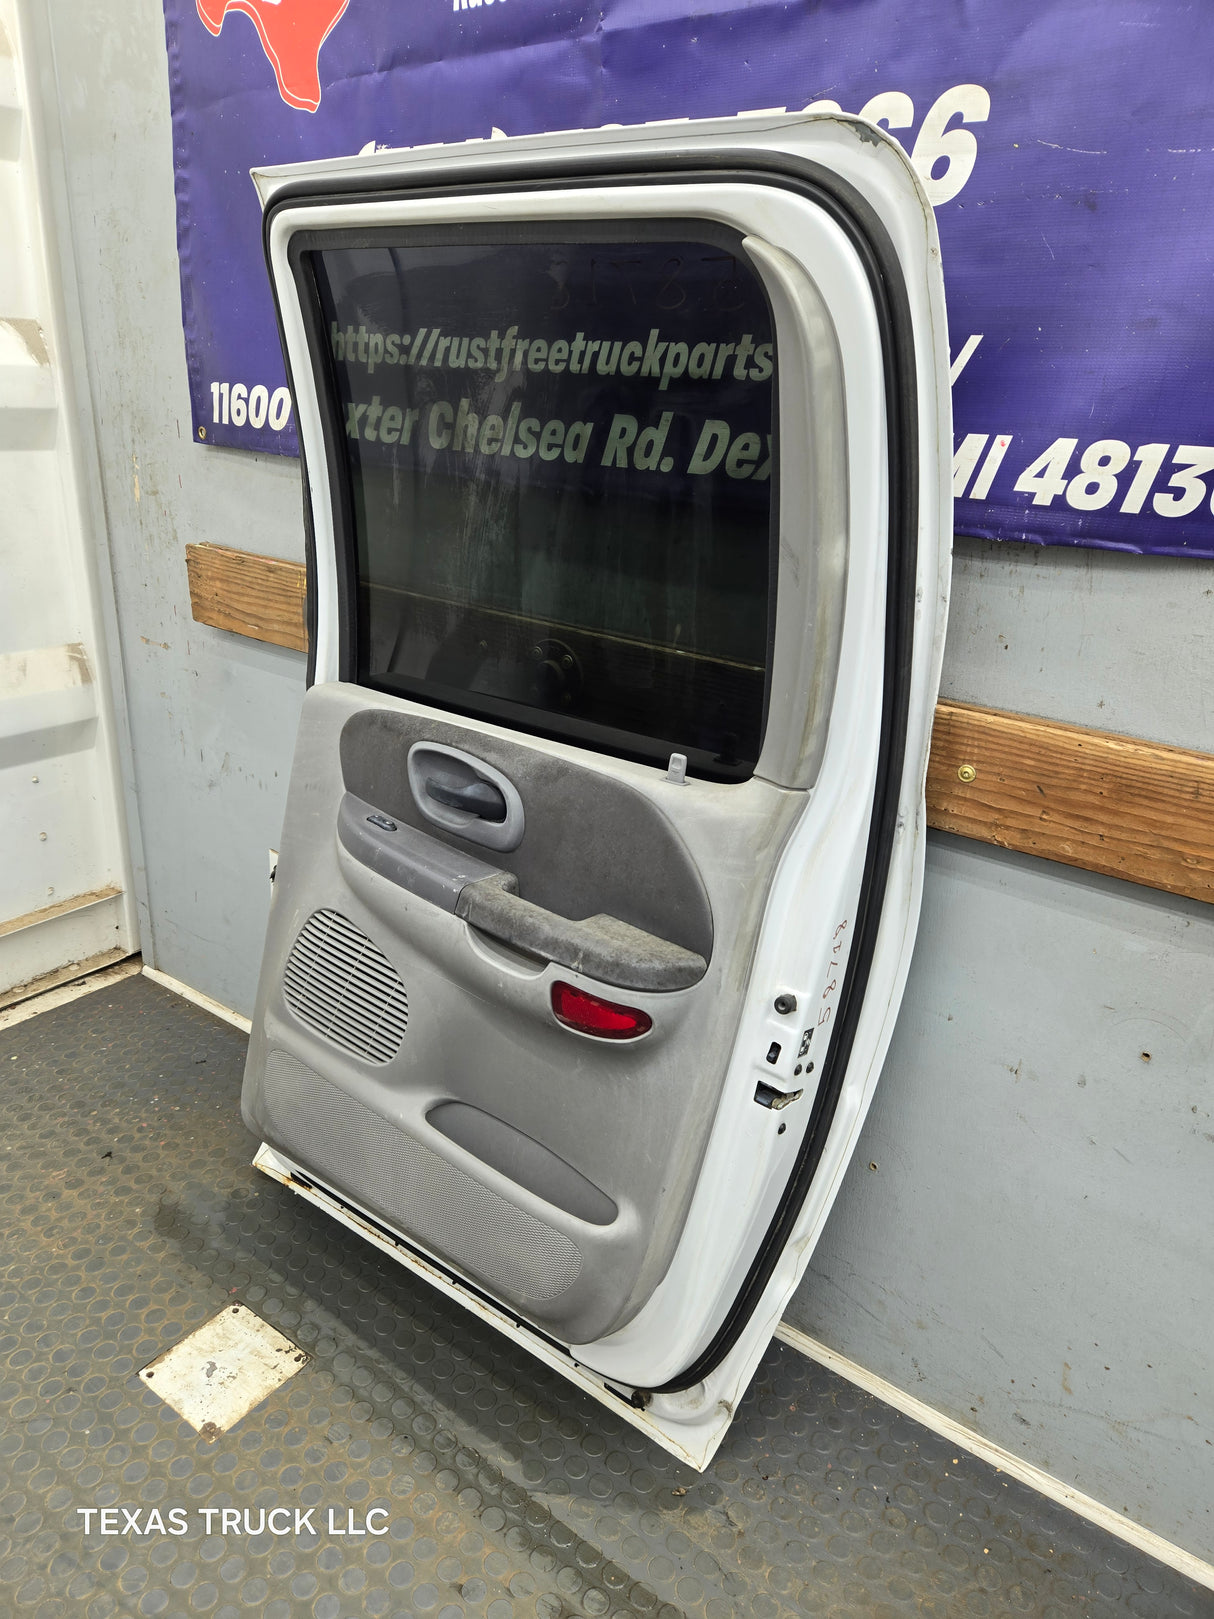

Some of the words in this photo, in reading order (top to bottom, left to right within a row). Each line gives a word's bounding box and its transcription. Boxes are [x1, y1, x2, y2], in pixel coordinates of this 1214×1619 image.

[210, 381, 292, 431] 11600
[428, 398, 594, 464] Chelsea
[600, 411, 674, 473] Rd.
[1013, 437, 1214, 518] 4813
[817, 919, 848, 1026] 58718
